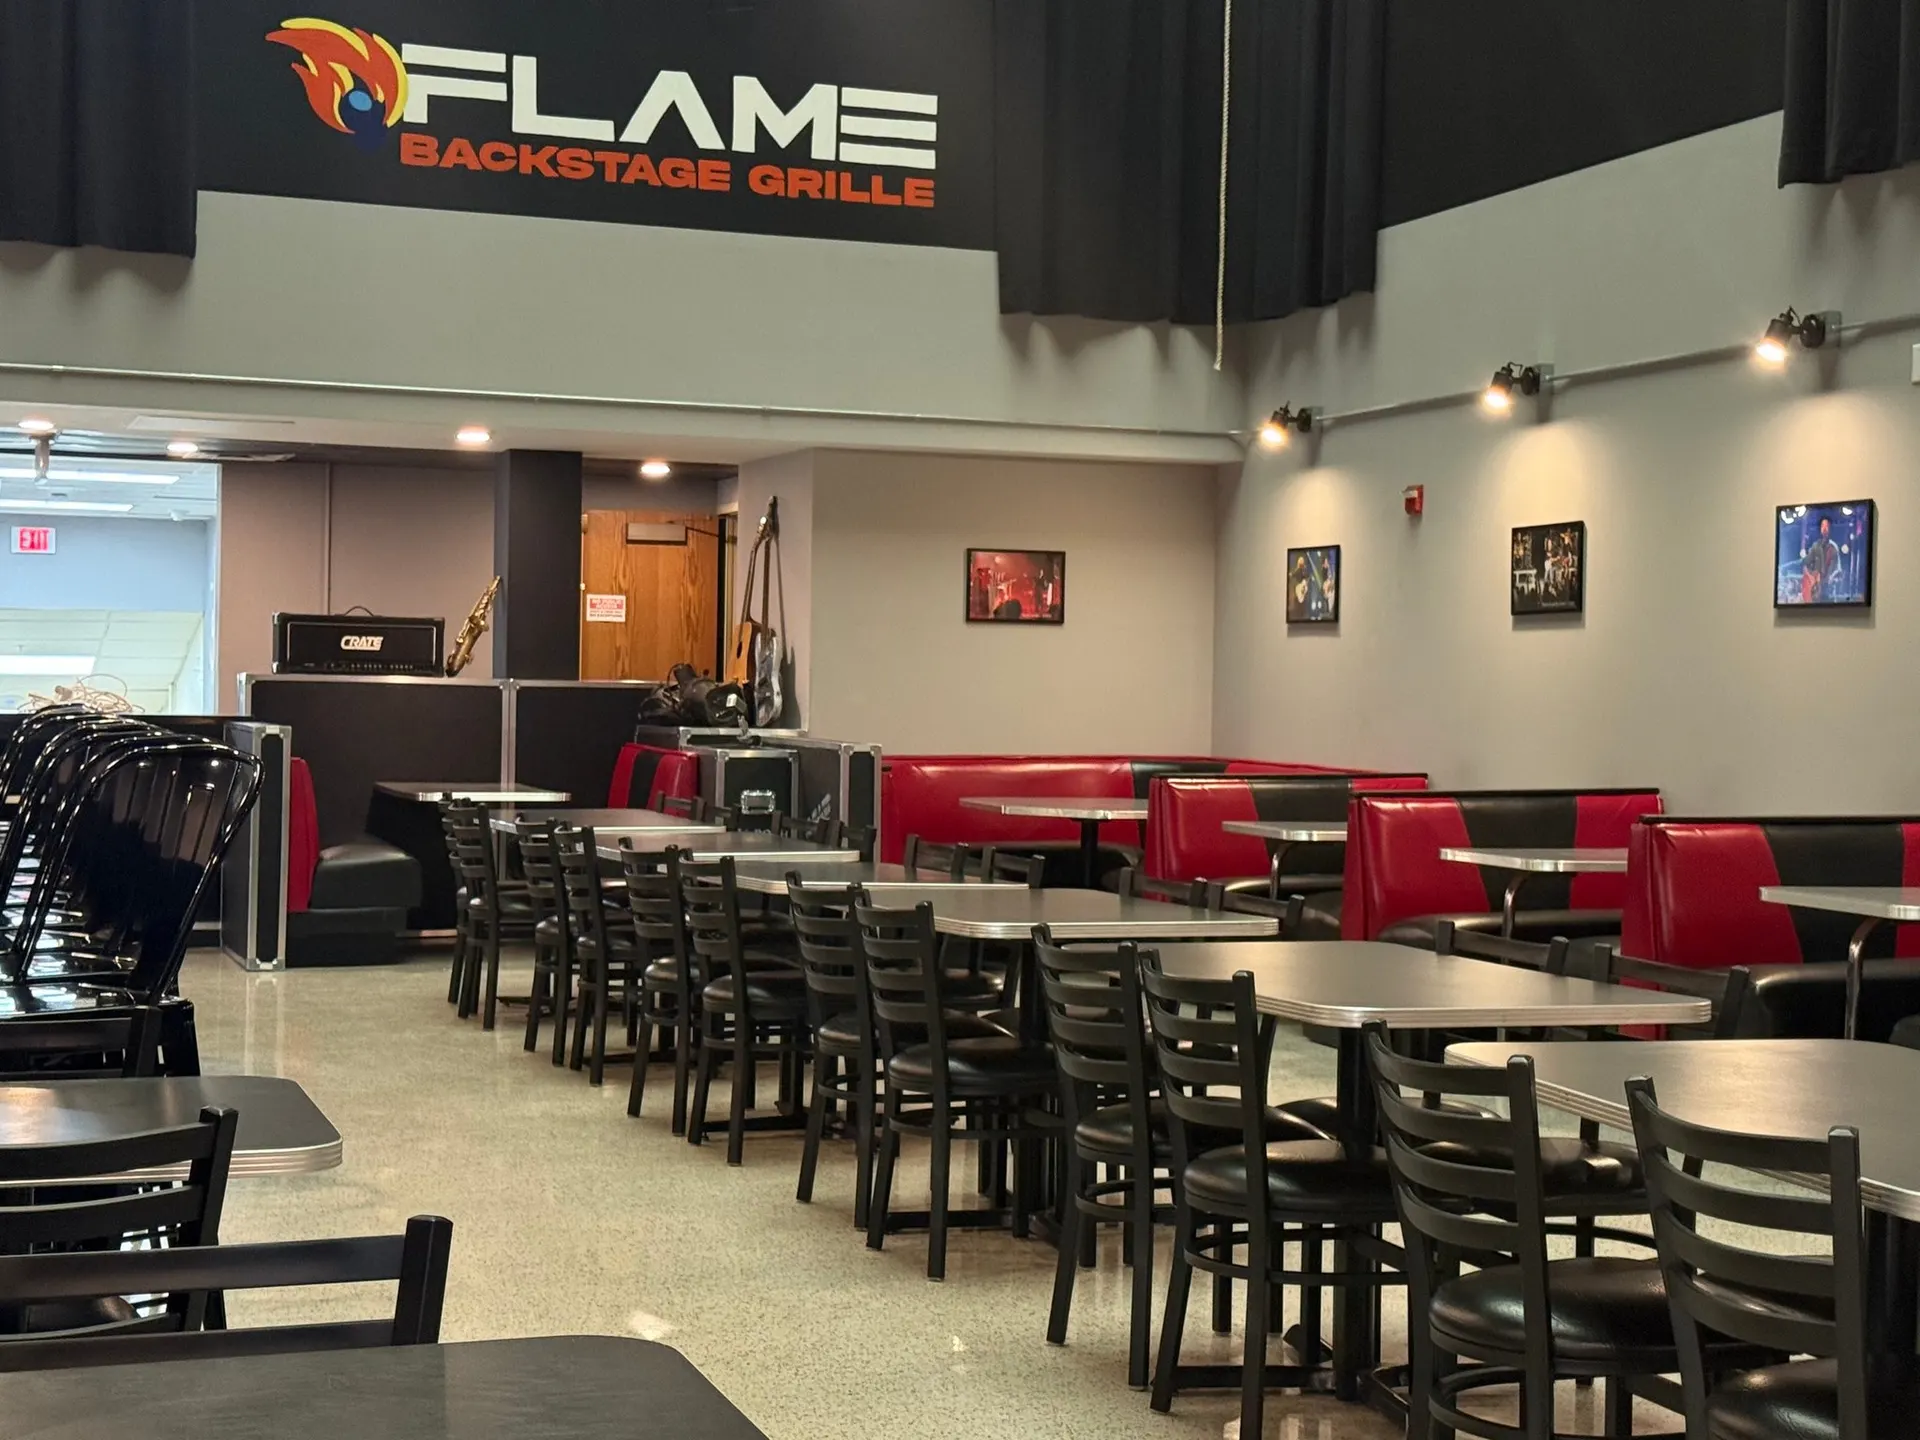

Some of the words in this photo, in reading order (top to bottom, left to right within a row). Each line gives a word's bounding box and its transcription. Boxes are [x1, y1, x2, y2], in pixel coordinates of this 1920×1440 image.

[401, 43, 938, 170] FLAME
[400, 133, 731, 192] BACKSTAGE
[747, 164, 936, 208] GRILLE
[19, 528, 49, 552] EXIT
[340, 635, 384, 651] CRATE
